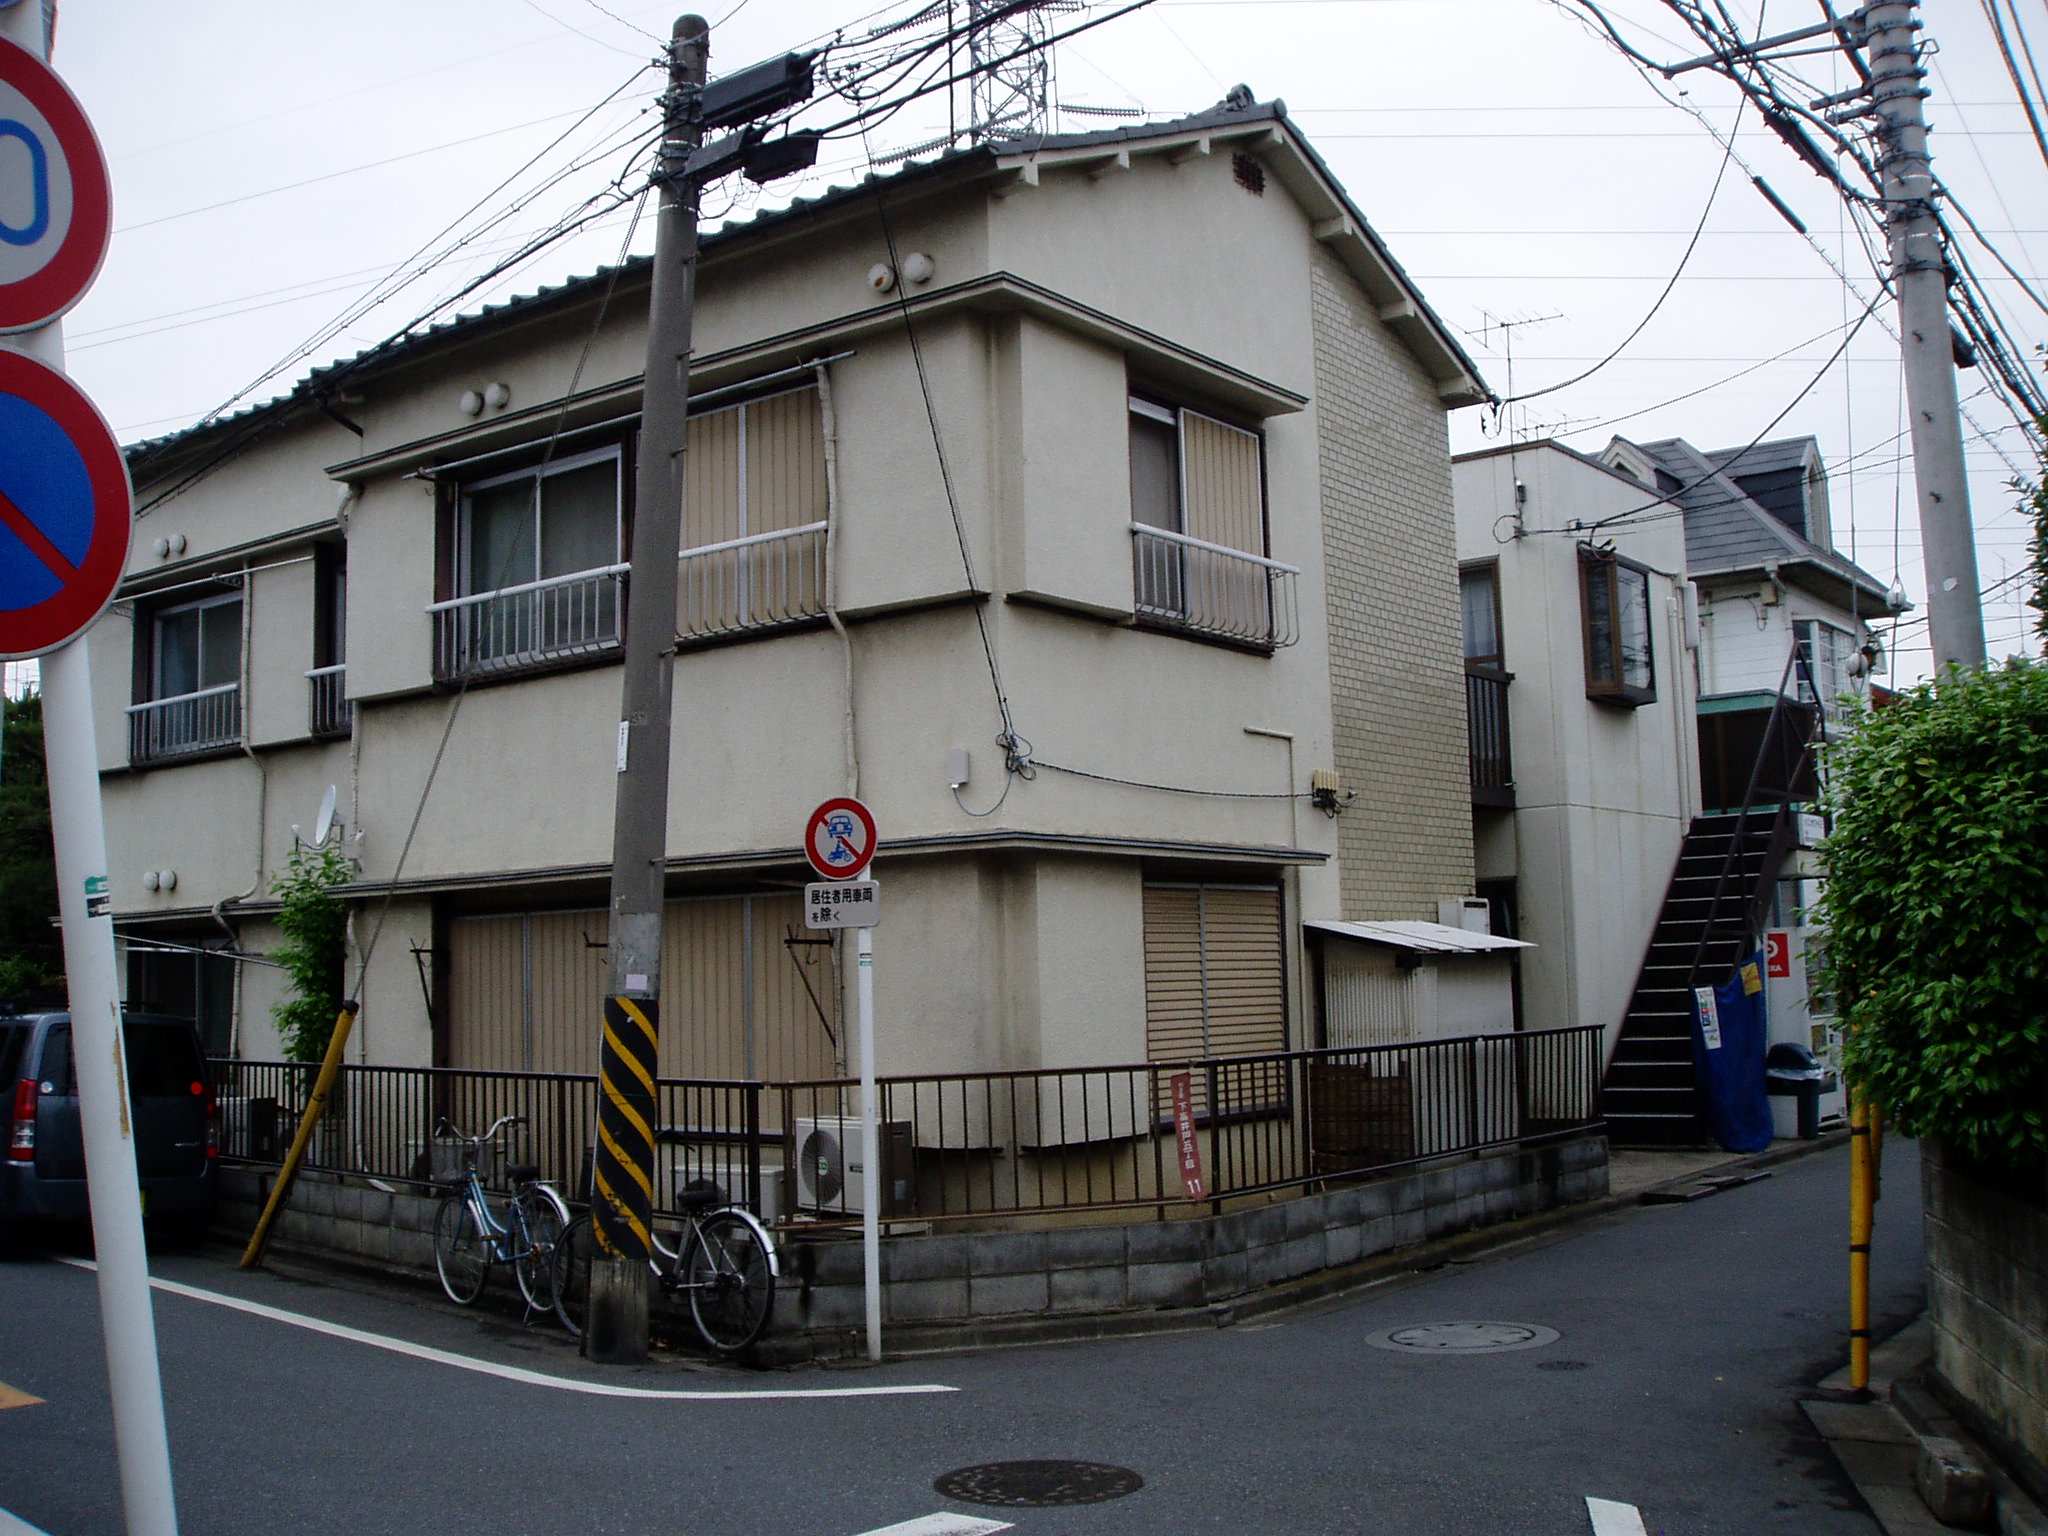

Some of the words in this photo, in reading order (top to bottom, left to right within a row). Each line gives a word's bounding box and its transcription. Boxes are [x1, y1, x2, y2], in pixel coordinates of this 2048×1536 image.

[811, 887, 872, 904] 居住者用車両
[811, 906, 840, 922] を除く
[1187, 1178, 1201, 1194] 11
